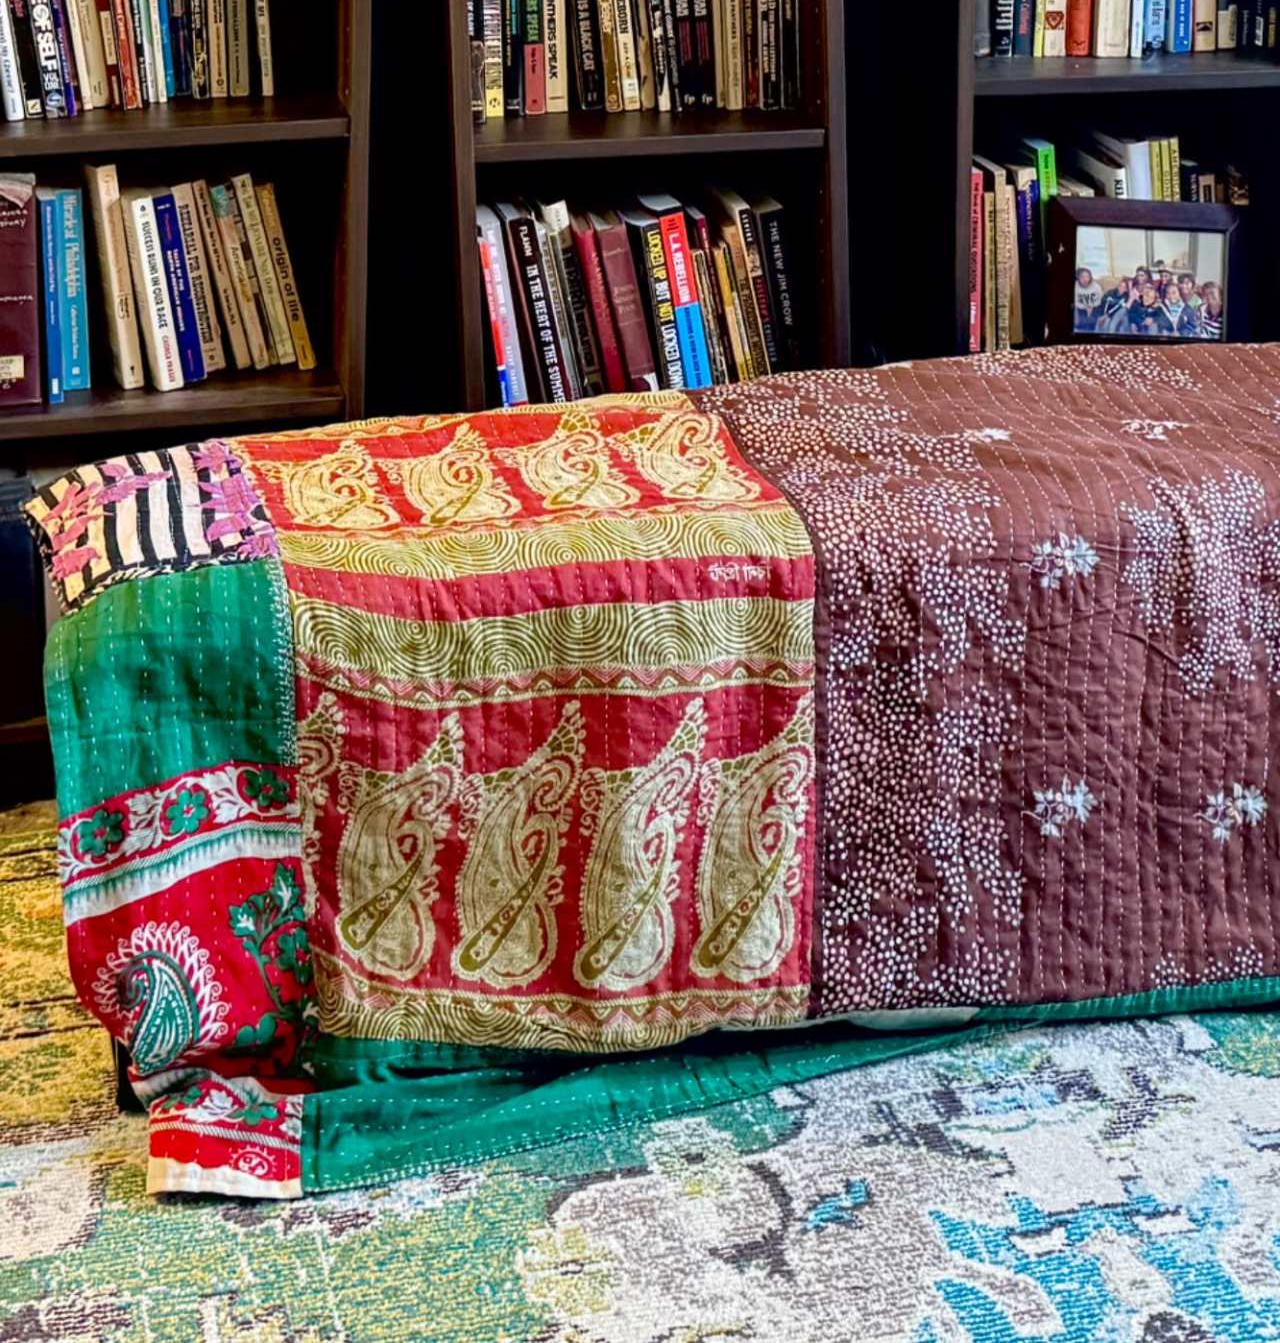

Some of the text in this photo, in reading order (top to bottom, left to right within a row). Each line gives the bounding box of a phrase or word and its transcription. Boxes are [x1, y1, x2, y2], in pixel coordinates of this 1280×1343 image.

[32, 4, 52, 31] OF
[38, 34, 59, 71] SELF
[548, 43, 559, 79] SPEAK
[141, 221, 156, 252] SUCCESS
[146, 254, 160, 275] RUNS
[271, 237, 301, 322] origin of life
[768, 221, 793, 326] THE NEW JIM CROW
[151, 288, 164, 307] OUR
[526, 264, 555, 364] IN THE HEAT OF THE
[156, 308, 168, 329] RACE
